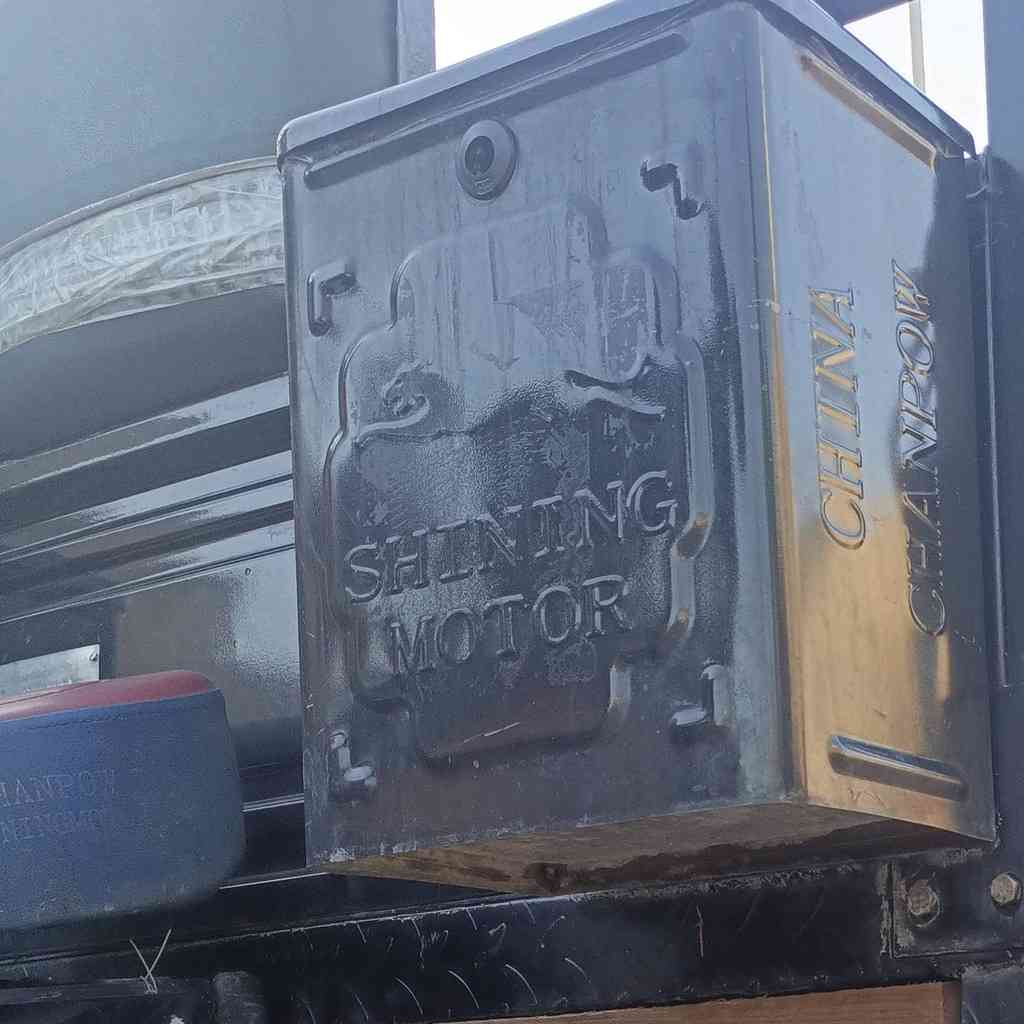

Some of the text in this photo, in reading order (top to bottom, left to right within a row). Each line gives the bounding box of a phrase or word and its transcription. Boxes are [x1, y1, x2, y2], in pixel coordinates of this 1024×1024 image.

[808, 287, 866, 550] CHINA
[345, 470, 678, 603] SHINING
[388, 575, 633, 673] MOTOR
